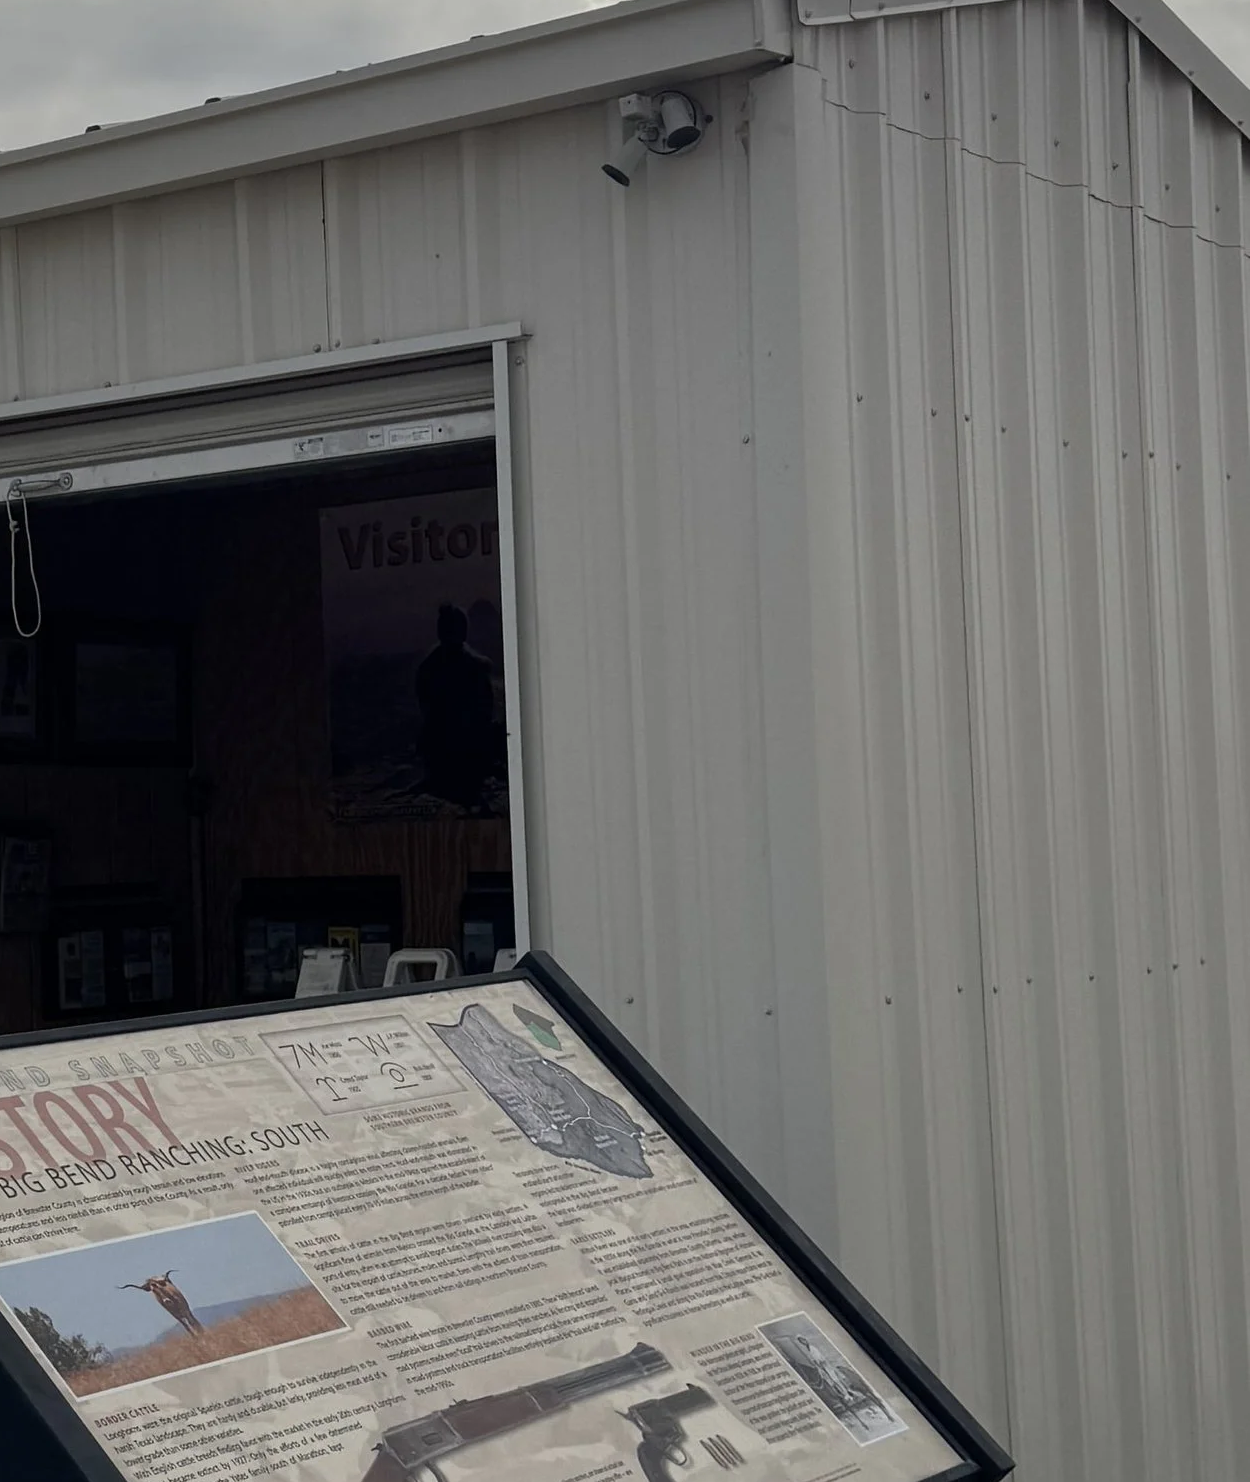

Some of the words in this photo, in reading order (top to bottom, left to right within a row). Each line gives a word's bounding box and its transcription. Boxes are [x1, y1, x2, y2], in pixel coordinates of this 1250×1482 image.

[338, 516, 497, 570] Visitor
[69, 1036, 253, 1080] SNAPSHOT
[45, 1159, 116, 1189] BEND
[119, 1136, 252, 1174] RANCHING:
[251, 1122, 329, 1151] SOUTH
[95, 1413, 129, 1428] BORDER
[129, 1404, 159, 1418] CATTLE
